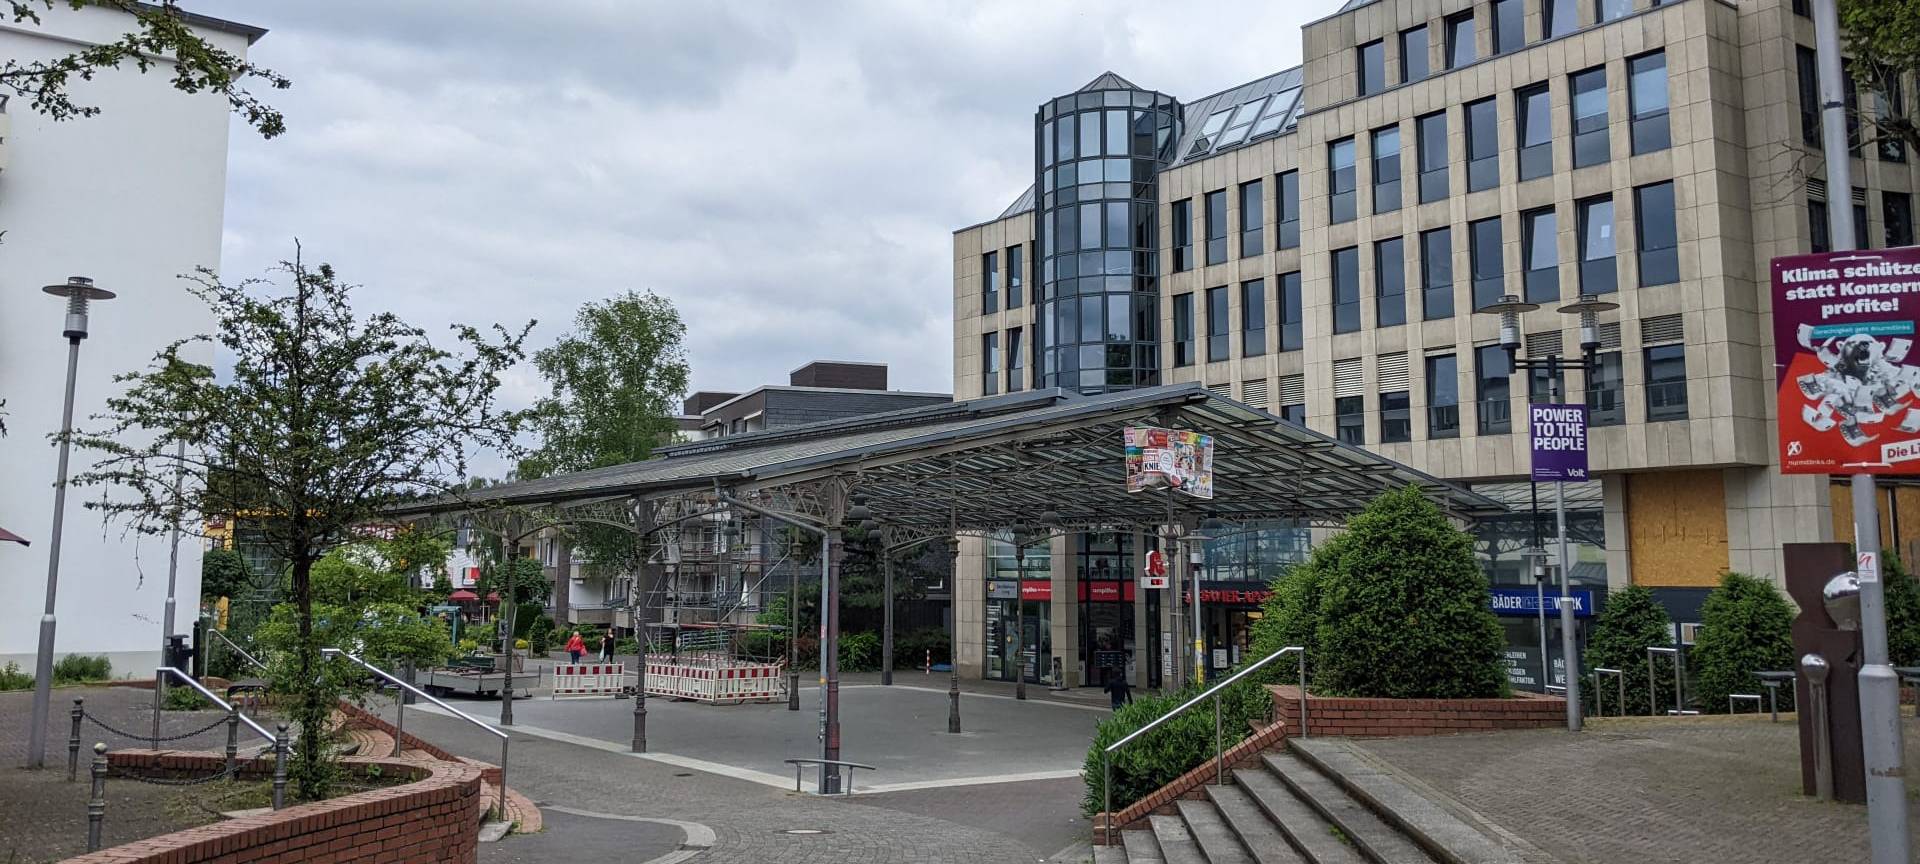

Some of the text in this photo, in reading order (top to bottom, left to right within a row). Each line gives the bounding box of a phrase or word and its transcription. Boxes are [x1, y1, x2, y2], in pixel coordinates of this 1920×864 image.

[1782, 268, 1839, 283] Klima
[1785, 284, 1835, 300] statt
[1821, 298, 1899, 319] profite!
[1533, 408, 1583, 422] POWER
[1534, 422, 1584, 437] TO THE
[1534, 437, 1585, 451] PEOPLE
[1887, 447, 1908, 459] Die
[1567, 468, 1585, 477] Volt
[1492, 593, 1521, 609] BÄDER
